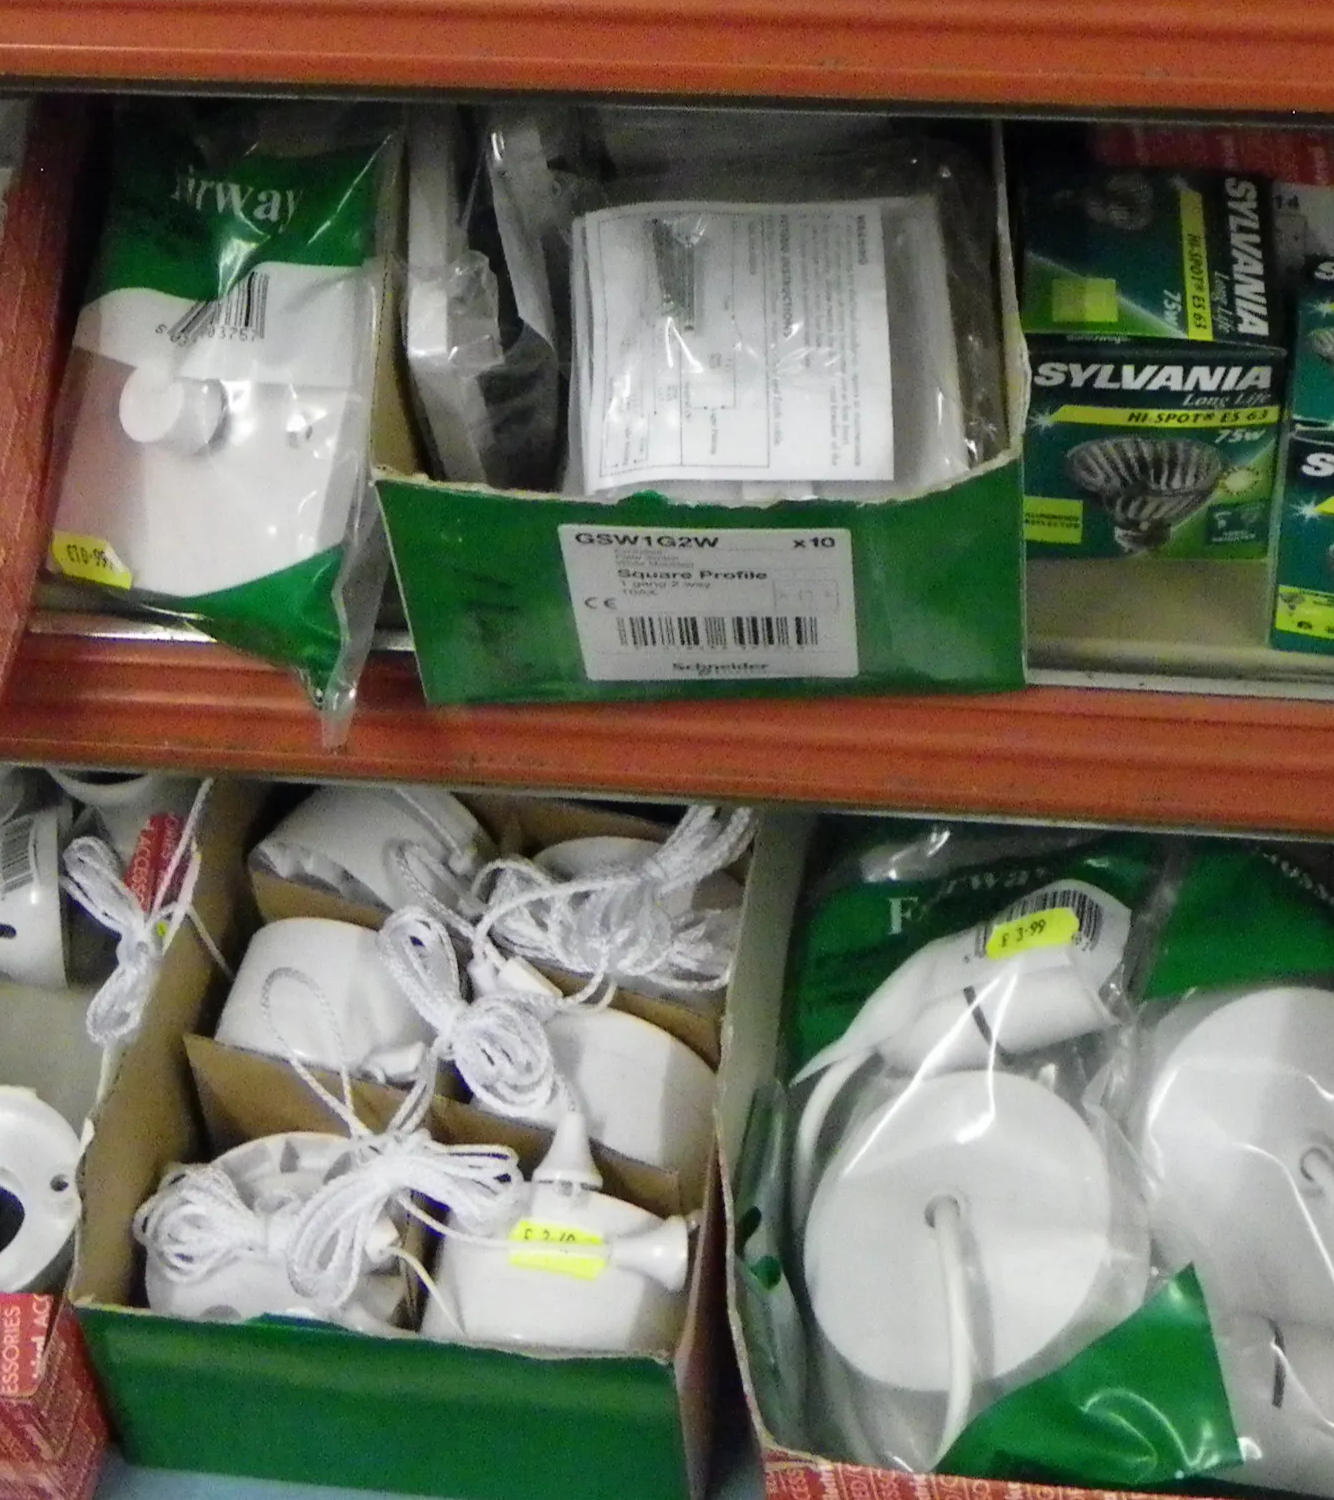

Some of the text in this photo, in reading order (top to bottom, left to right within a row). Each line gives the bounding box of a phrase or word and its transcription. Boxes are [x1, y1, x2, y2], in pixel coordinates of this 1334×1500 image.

[1223, 176, 1271, 338] SYLVANIA
[1033, 361, 1273, 392] SYLVANIA
[574, 531, 721, 549] GSW1G2W
[616, 568, 768, 581] Square Profile
